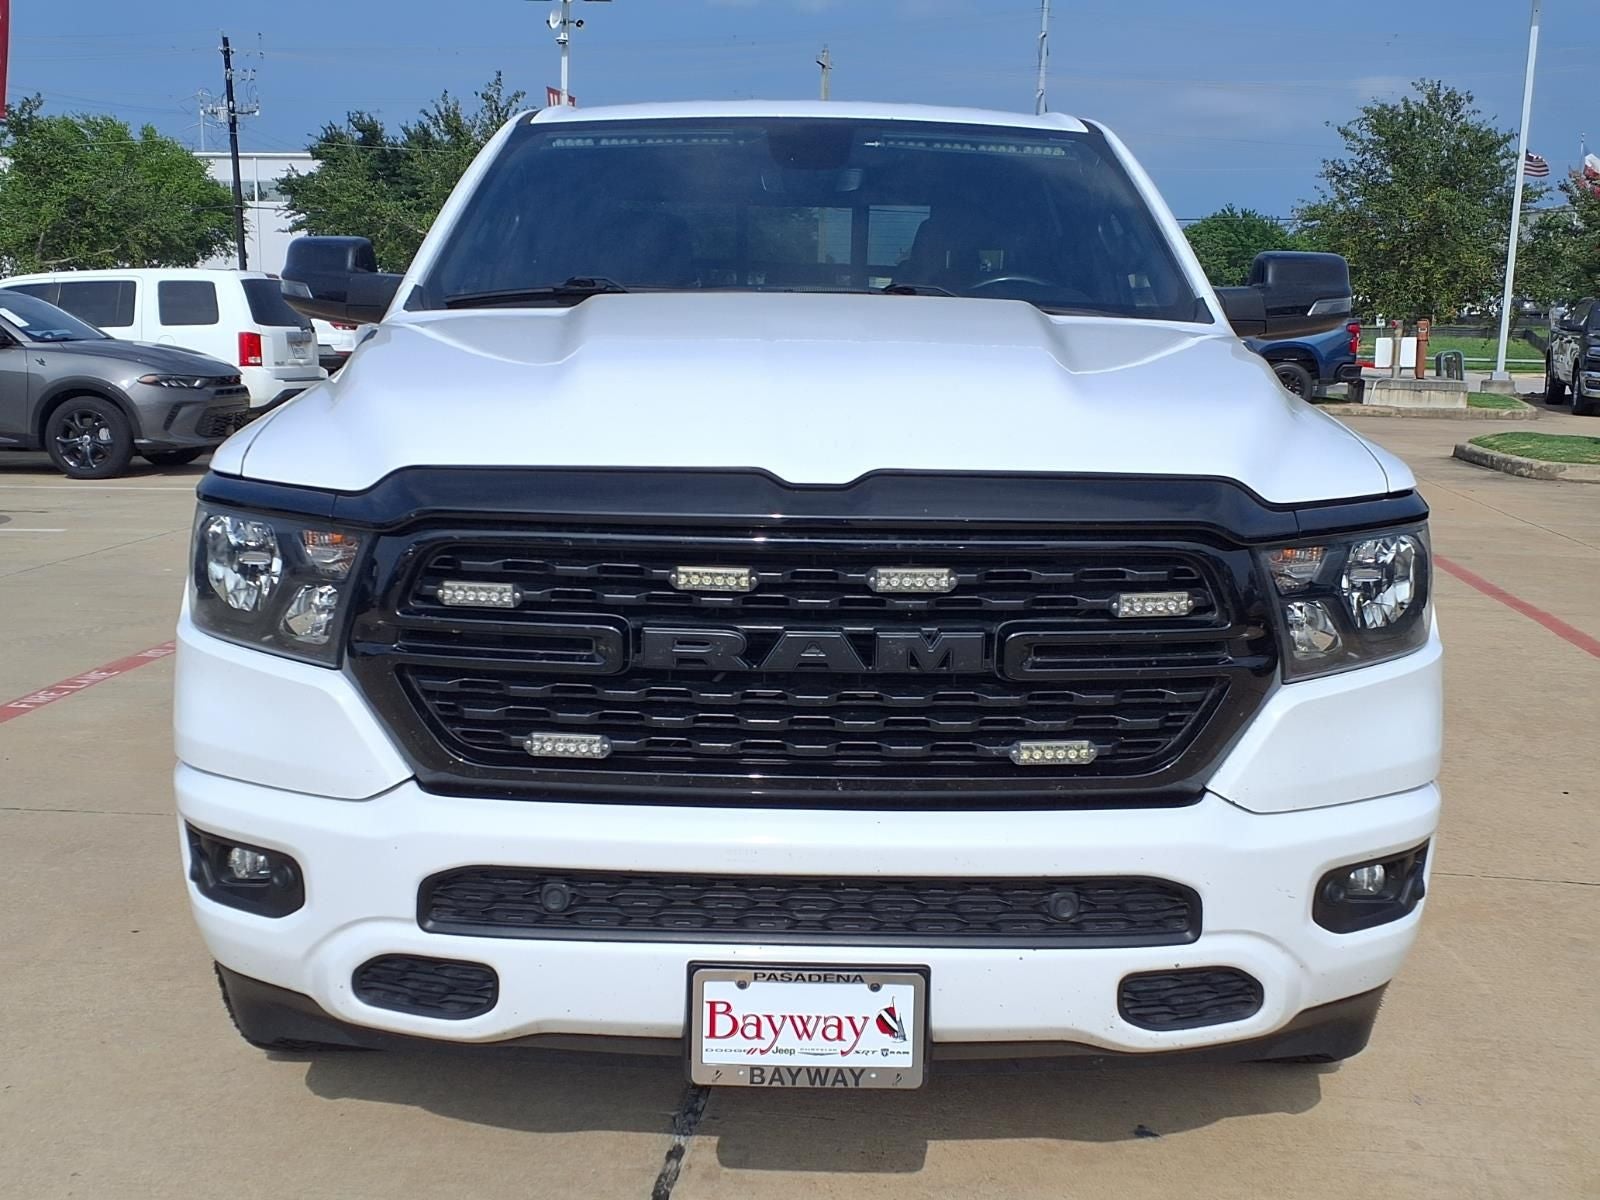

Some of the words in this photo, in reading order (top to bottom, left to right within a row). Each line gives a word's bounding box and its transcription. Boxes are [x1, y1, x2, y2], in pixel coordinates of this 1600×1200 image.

[642, 626, 985, 673] RAM
[753, 972, 866, 984] PASADENA
[704, 1000, 871, 1058] Bayway
[771, 1045, 796, 1056] Jeep
[749, 1066, 866, 1087] BAYWAY
